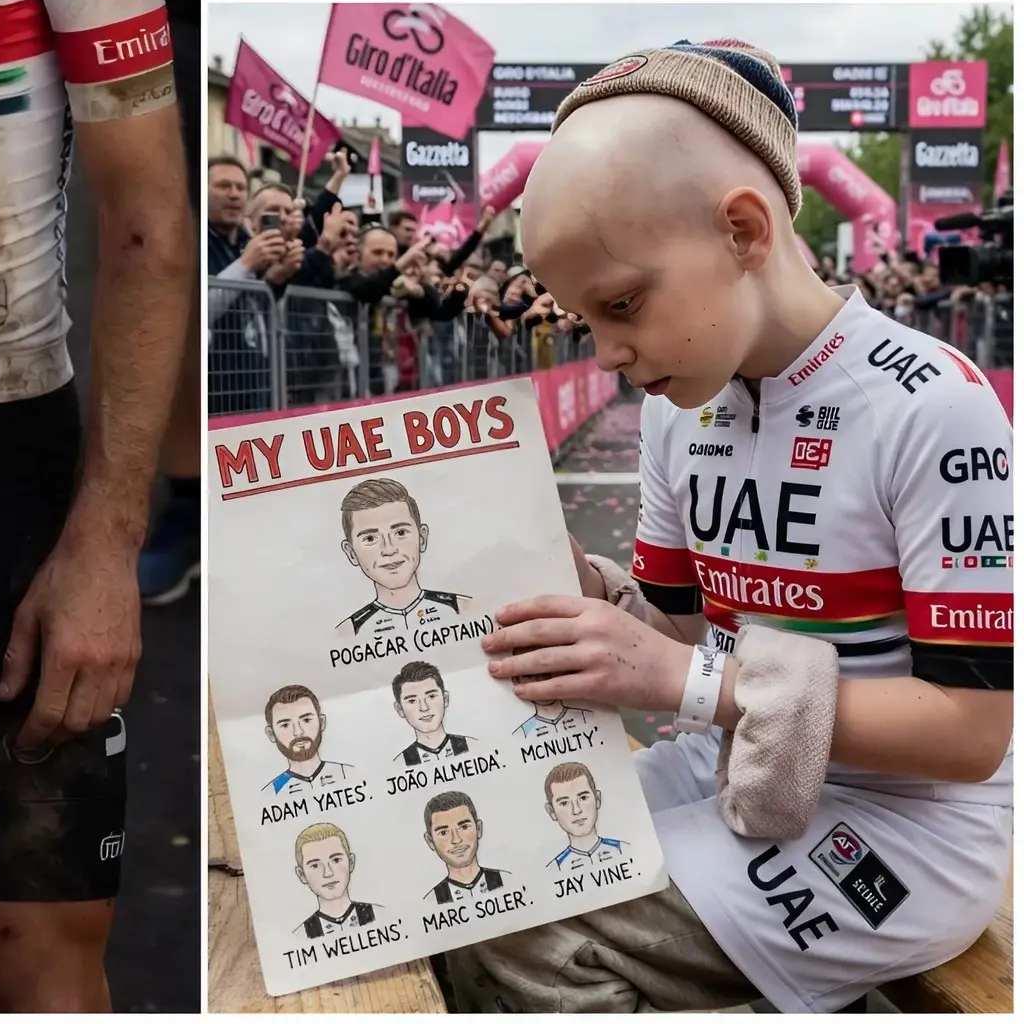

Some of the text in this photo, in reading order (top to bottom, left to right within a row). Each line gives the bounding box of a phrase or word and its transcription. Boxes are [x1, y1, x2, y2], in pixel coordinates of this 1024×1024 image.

[346, 32, 390, 77] Giro
[388, 52, 459, 106] d'Italia
[406, 141, 470, 167] Gazzetta
[787, 331, 846, 388] Emirates
[868, 338, 942, 395] UAE
[215, 396, 515, 488] MY UAE BOYS
[688, 474, 822, 557] UAE
[694, 559, 825, 612] Emirates
[330, 614, 495, 668] POGAČAR (CAPTAIN)
[386, 770, 429, 796] JOÃO
[261, 798, 309, 825] ADAM
[554, 875, 585, 898] JAY
[747, 844, 840, 952] UAE
[422, 905, 470, 933] MARC
[283, 946, 319, 970] TIM
